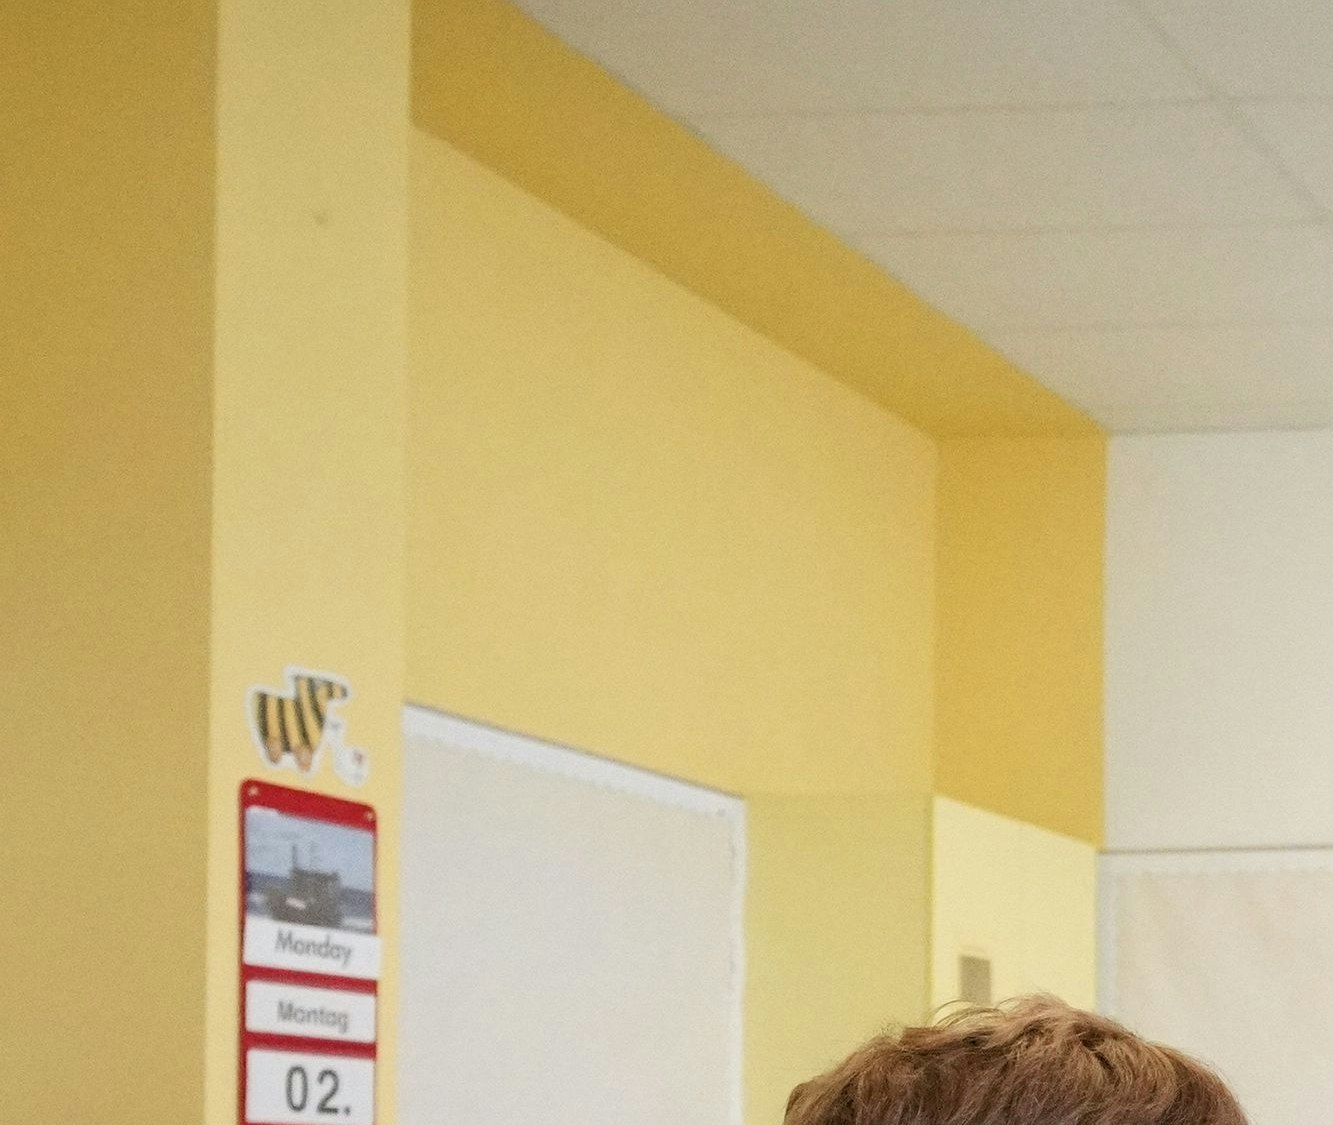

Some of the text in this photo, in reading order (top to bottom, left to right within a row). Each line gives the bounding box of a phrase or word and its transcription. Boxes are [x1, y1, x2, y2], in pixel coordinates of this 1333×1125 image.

[275, 928, 352, 967] Monday
[278, 999, 348, 1033] Montag
[286, 1066, 351, 1115] 02.
